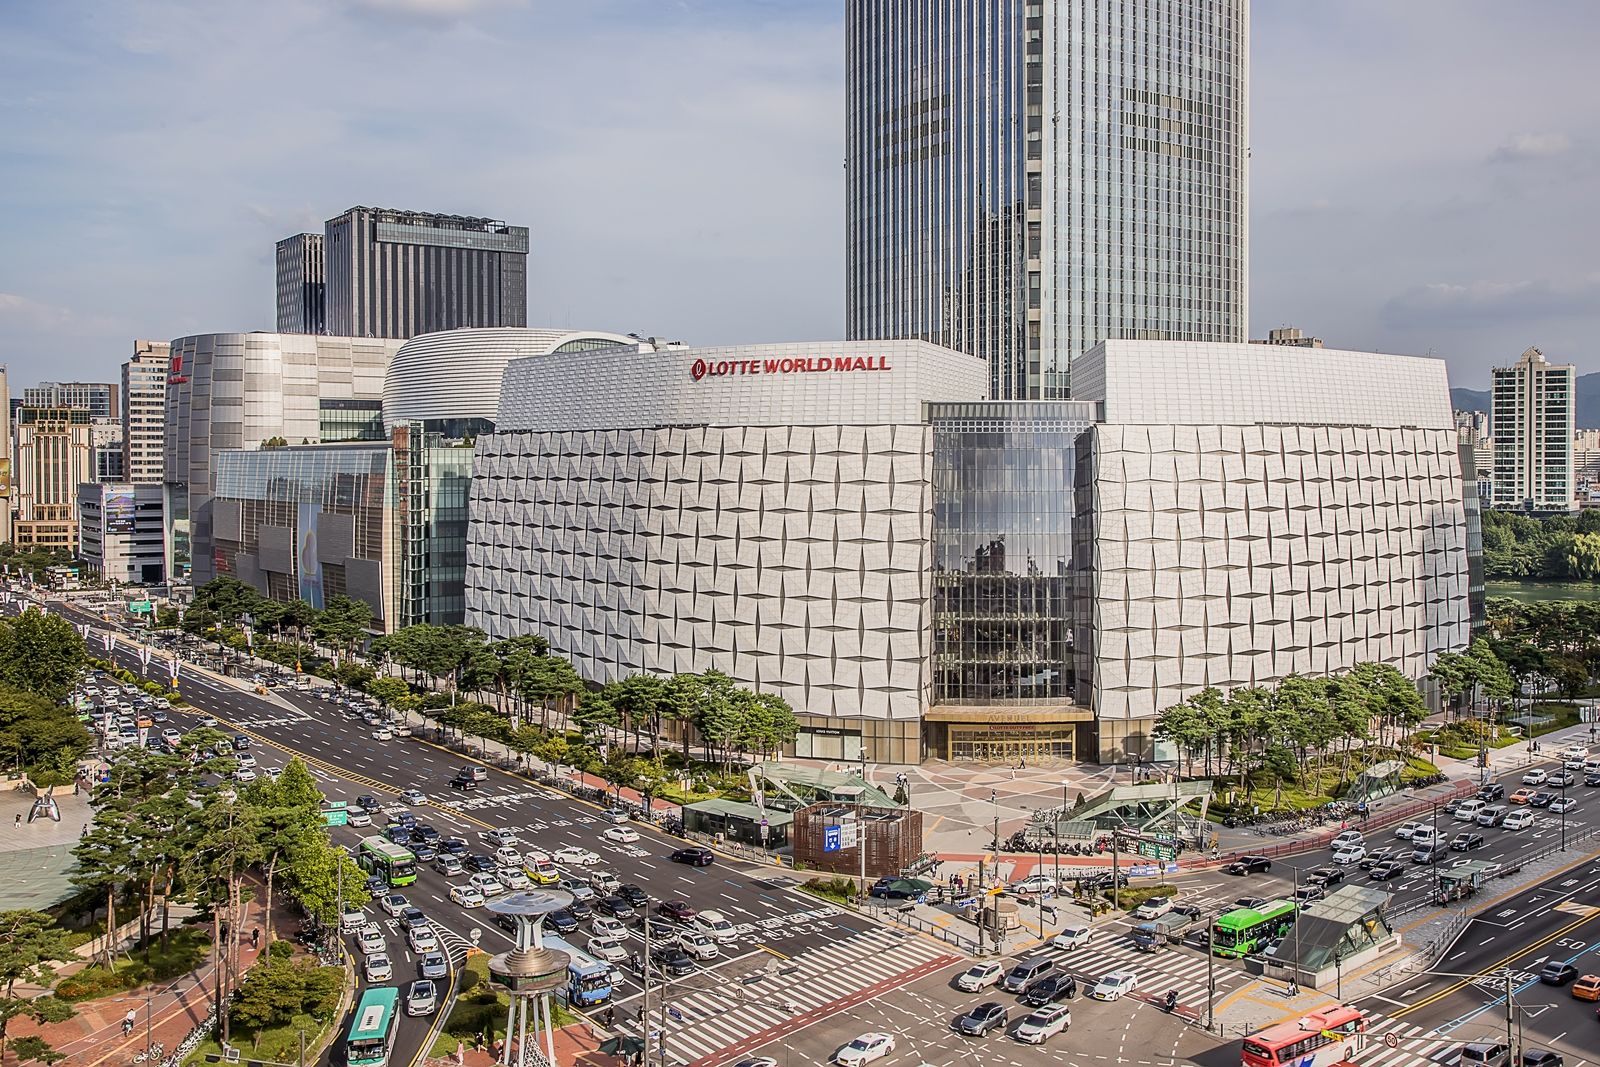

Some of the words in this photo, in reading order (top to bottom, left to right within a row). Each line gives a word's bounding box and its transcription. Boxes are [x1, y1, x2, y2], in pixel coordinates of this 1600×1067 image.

[709, 360, 760, 376] LOTTE
[764, 357, 832, 374] WORLD
[834, 356, 892, 371] MALL
[988, 714, 1031, 722] AVENUEL
[1556, 937, 1587, 950] 50
[1386, 1036, 1396, 1046] 50
